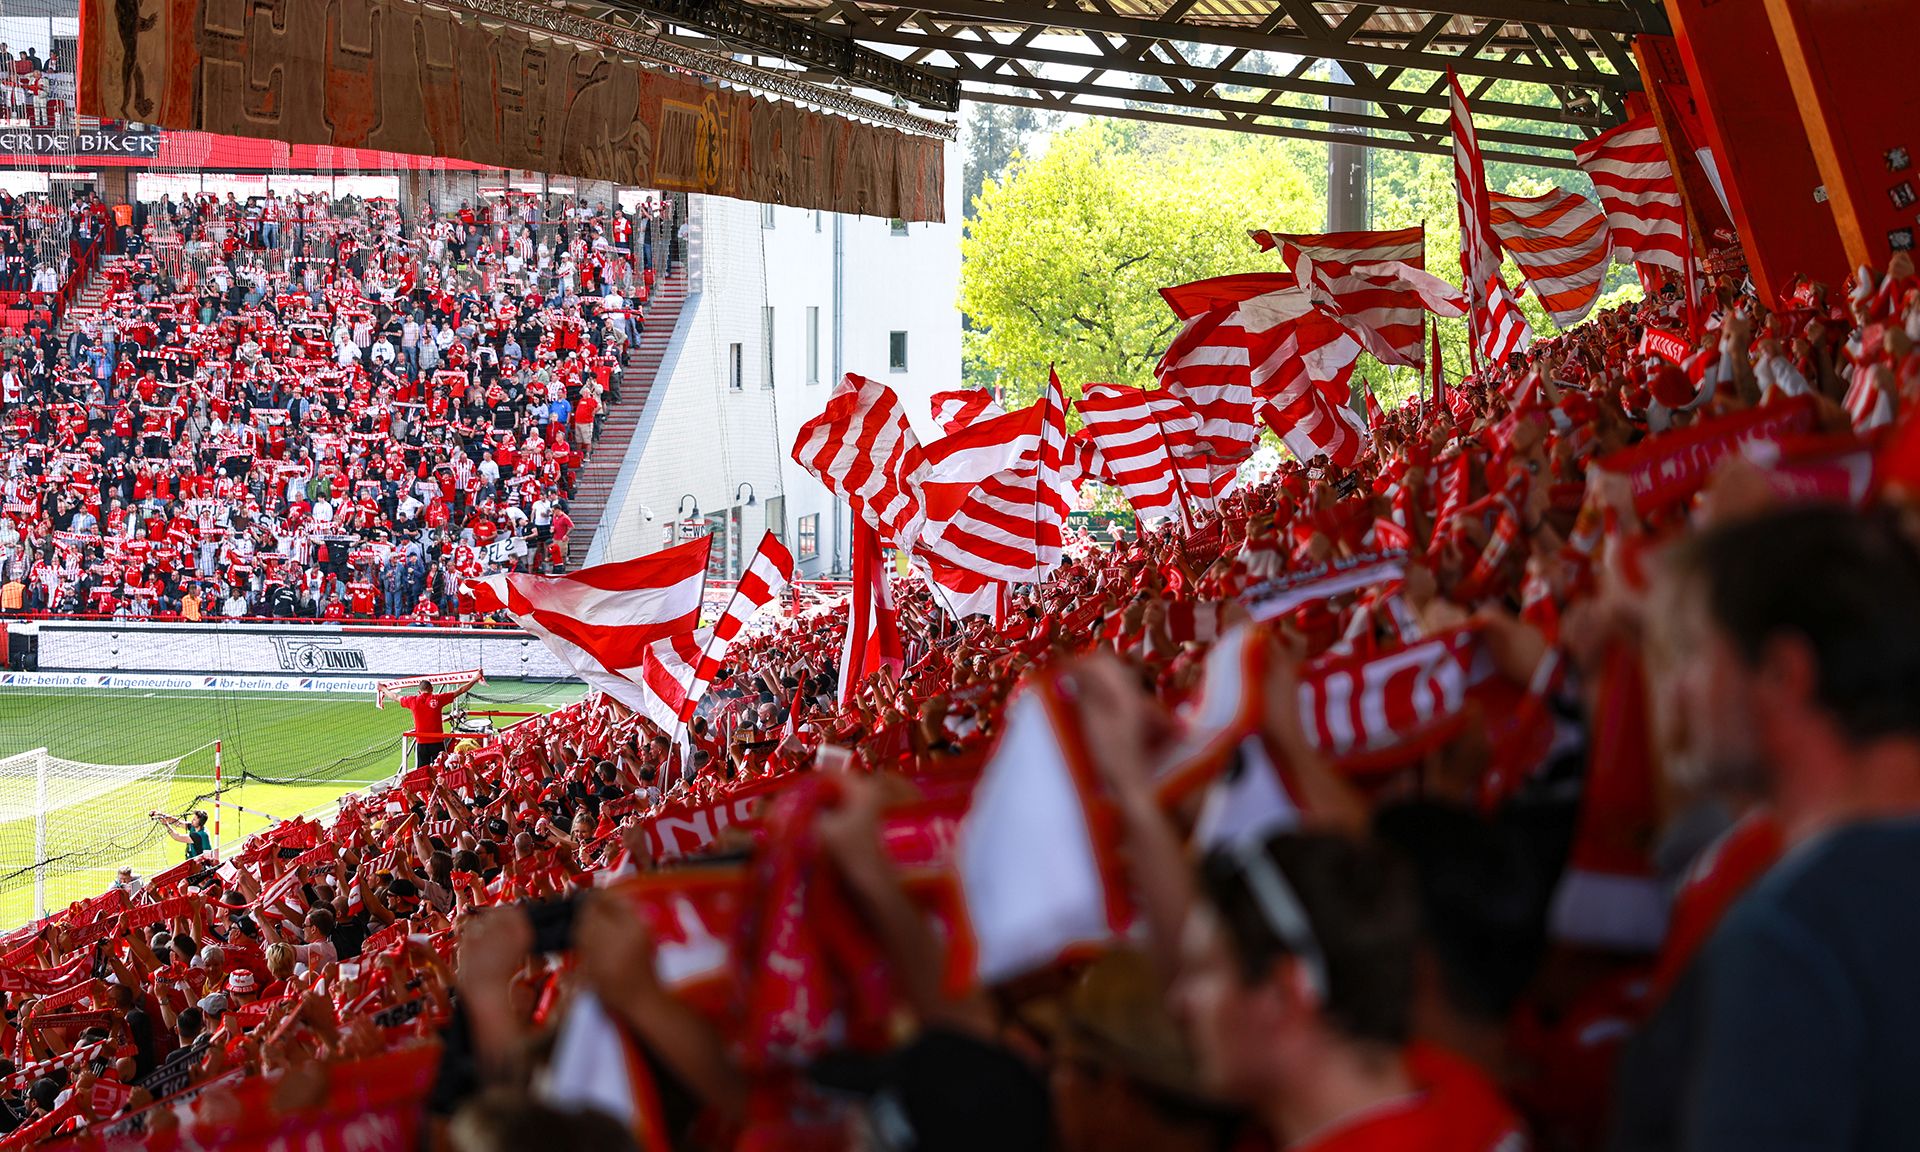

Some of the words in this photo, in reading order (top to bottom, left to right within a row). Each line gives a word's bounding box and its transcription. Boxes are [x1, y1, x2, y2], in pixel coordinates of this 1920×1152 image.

[692, 525, 706, 538] WC
[324, 650, 365, 669] UNION
[17, 675, 88, 686] ibr-berlin.de
[113, 677, 193, 689] Ingenieurbüro
[219, 678, 290, 690] ibr-berlin.de
